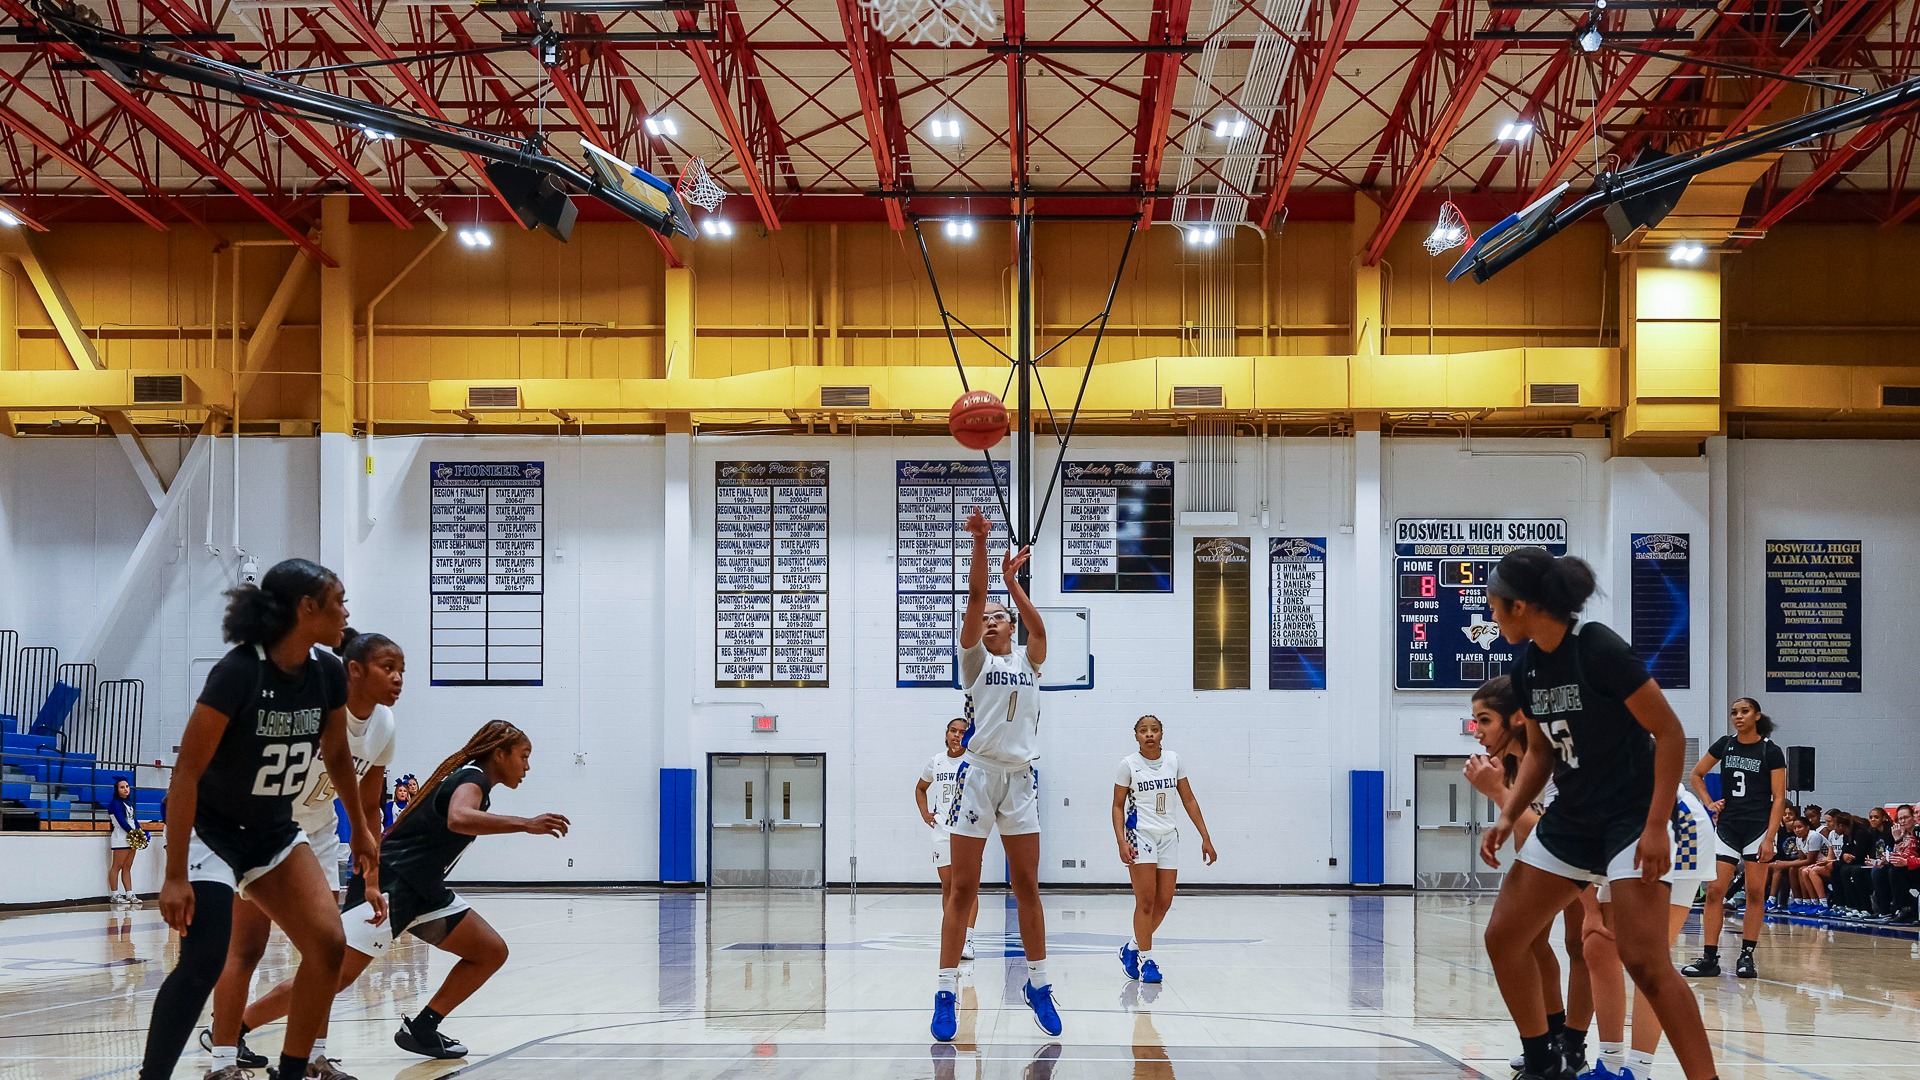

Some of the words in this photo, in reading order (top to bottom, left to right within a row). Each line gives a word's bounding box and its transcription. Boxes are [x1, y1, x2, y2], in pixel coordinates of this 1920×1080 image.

[454, 465, 520, 476] PIONEER
[919, 463, 947, 475] Lady
[1083, 464, 1111, 476] Lady
[434, 489, 454, 497] REGION
[461, 489, 484, 497] FINALIST
[496, 489, 510, 497] STATE
[512, 489, 534, 497] PLAYOFFS
[719, 489, 735, 497] STATE
[737, 489, 752, 497] FINAL
[754, 489, 768, 497] FOUR
[900, 488, 919, 496] REGION
[924, 488, 951, 496] RUNNER-UP
[775, 506, 798, 514] DISTRICT
[799, 506, 826, 514] CHAMPION
[775, 523, 796, 531] DISTRICT
[798, 523, 825, 531] CHAMPIONS
[1400, 523, 1464, 541] BOSWELL
[1469, 523, 1502, 541] HIGH
[1508, 523, 1564, 541] SCHOOL
[433, 541, 448, 549] STATE
[450, 541, 485, 549] SEMI-FINALIST
[496, 541, 510, 549] STATE
[512, 541, 534, 549] PLAYOFFS
[781, 540, 795, 548] STATE
[797, 540, 819, 548] PLAYOFFS
[1633, 535, 1688, 549] PIONEER
[1415, 546, 1448, 554] HOME
[1450, 546, 1465, 554] OF
[1468, 546, 1489, 554] THE
[1767, 544, 1825, 553] BOSWELL
[1827, 544, 1860, 553] HIGH
[436, 559, 453, 567] STATE
[455, 559, 481, 567] PLAYOFFS
[1773, 556, 1809, 564] ALMA
[1811, 556, 1854, 564] MATER
[1404, 562, 1433, 571] HOME
[432, 576, 455, 584] DISTRICT
[456, 576, 485, 584] CHAMPIONS
[496, 576, 510, 584] STATE
[511, 576, 534, 584] PLAYOFFS
[1421, 576, 1434, 596] 8
[900, 596, 925, 604] BI-DISTRICT
[926, 596, 952, 604] CHAMPIONS
[779, 613, 789, 621] REG.
[790, 613, 821, 621] SEMI-FINALIST
[1414, 624, 1425, 640] 5
[725, 665, 737, 673] AREA
[739, 665, 763, 673] CHAMPION
[1007, 691, 1017, 722] 1
[252, 742, 312, 795] 22
[937, 773, 955, 781] BOSW
[1732, 771, 1746, 797] 3
[1156, 793, 1166, 815] 0
